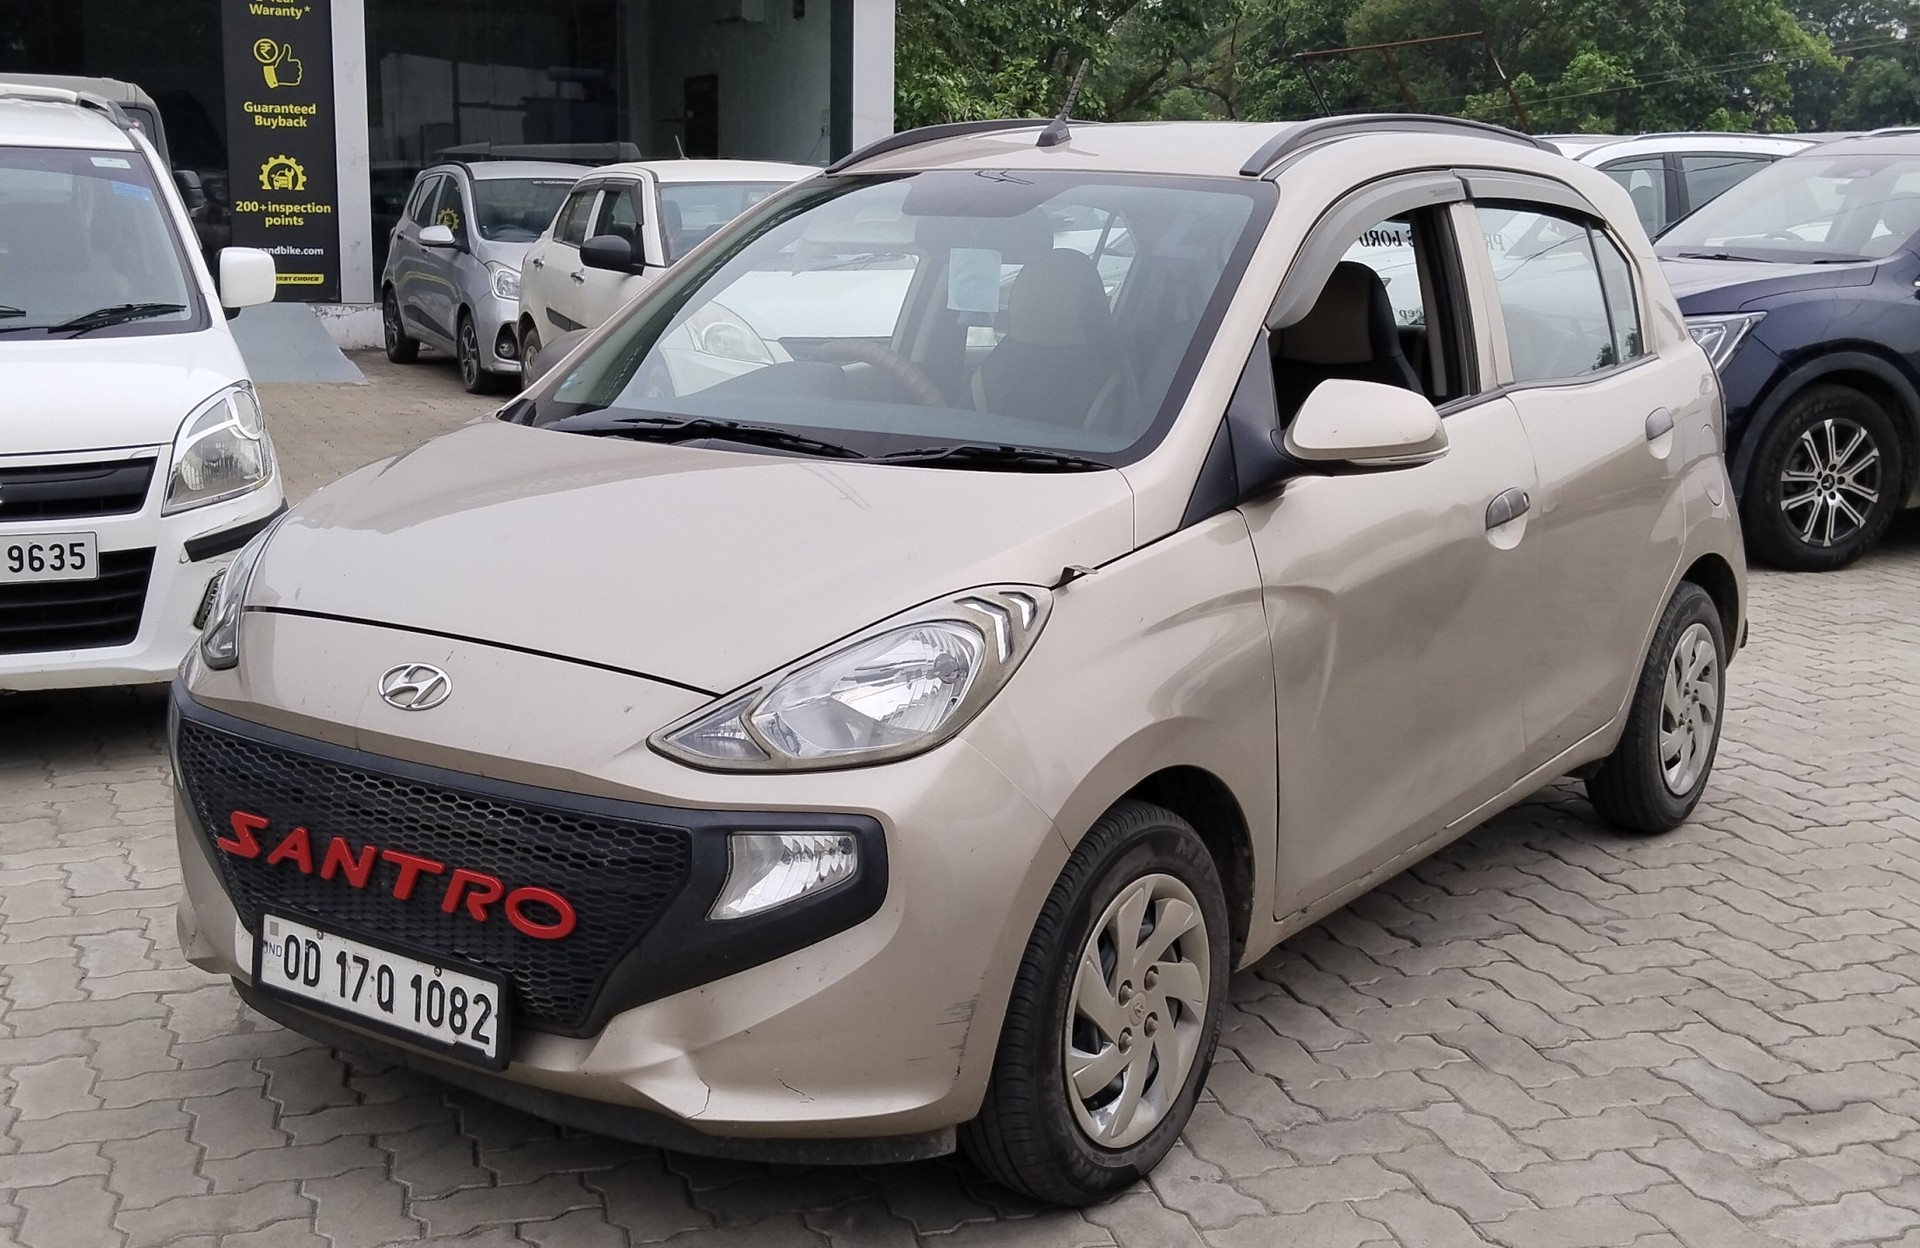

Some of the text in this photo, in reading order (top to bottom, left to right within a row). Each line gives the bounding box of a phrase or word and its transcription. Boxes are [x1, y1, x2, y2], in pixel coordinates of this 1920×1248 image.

[243, 101, 317, 115] Guaranteed
[254, 115, 308, 129] Buyback
[265, 215, 304, 228] points
[7, 542, 86, 573] 9635
[216, 810, 577, 940] SANTRO
[283, 933, 321, 988] OD
[410, 973, 492, 1045] 1082
